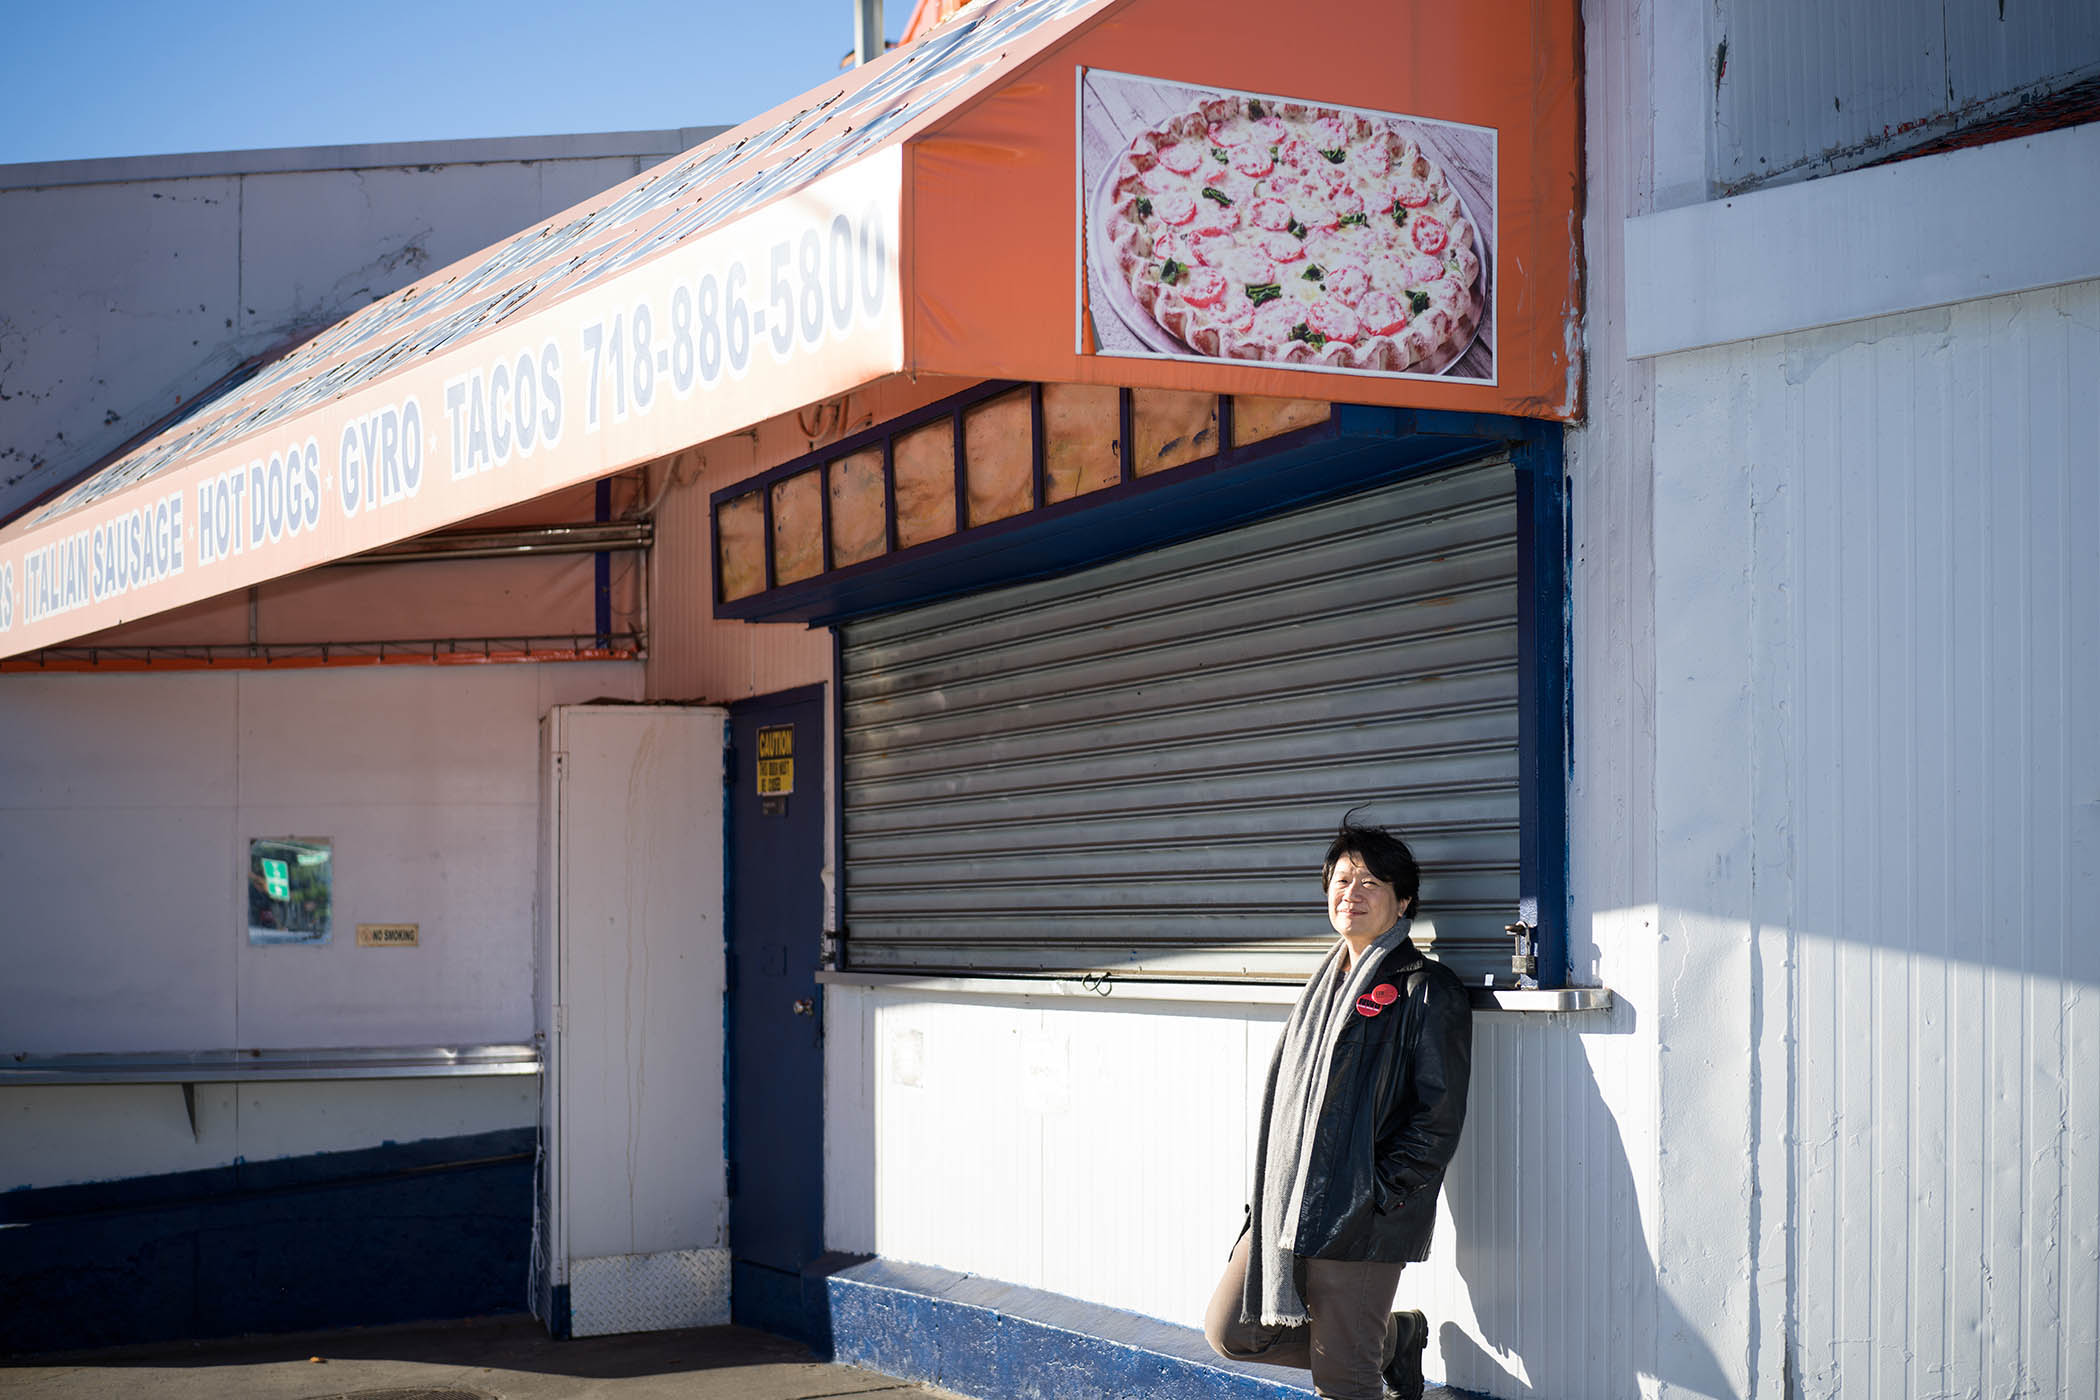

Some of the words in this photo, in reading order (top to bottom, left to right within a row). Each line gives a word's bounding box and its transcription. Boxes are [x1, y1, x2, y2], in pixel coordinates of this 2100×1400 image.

[0, 562, 13, 630] S
[25, 530, 89, 622] ITALIAN
[93, 492, 183, 600] SAUSAGE
[199, 471, 245, 565] HOT
[252, 438, 319, 548] DOGS
[341, 398, 422, 514] GYRO
[446, 341, 562, 477] TACOS
[583, 203, 886, 428] 718-886-5800
[760, 730, 793, 757] CAUTION
[373, 929, 383, 941] NO
[384, 929, 416, 941] SMOKING
